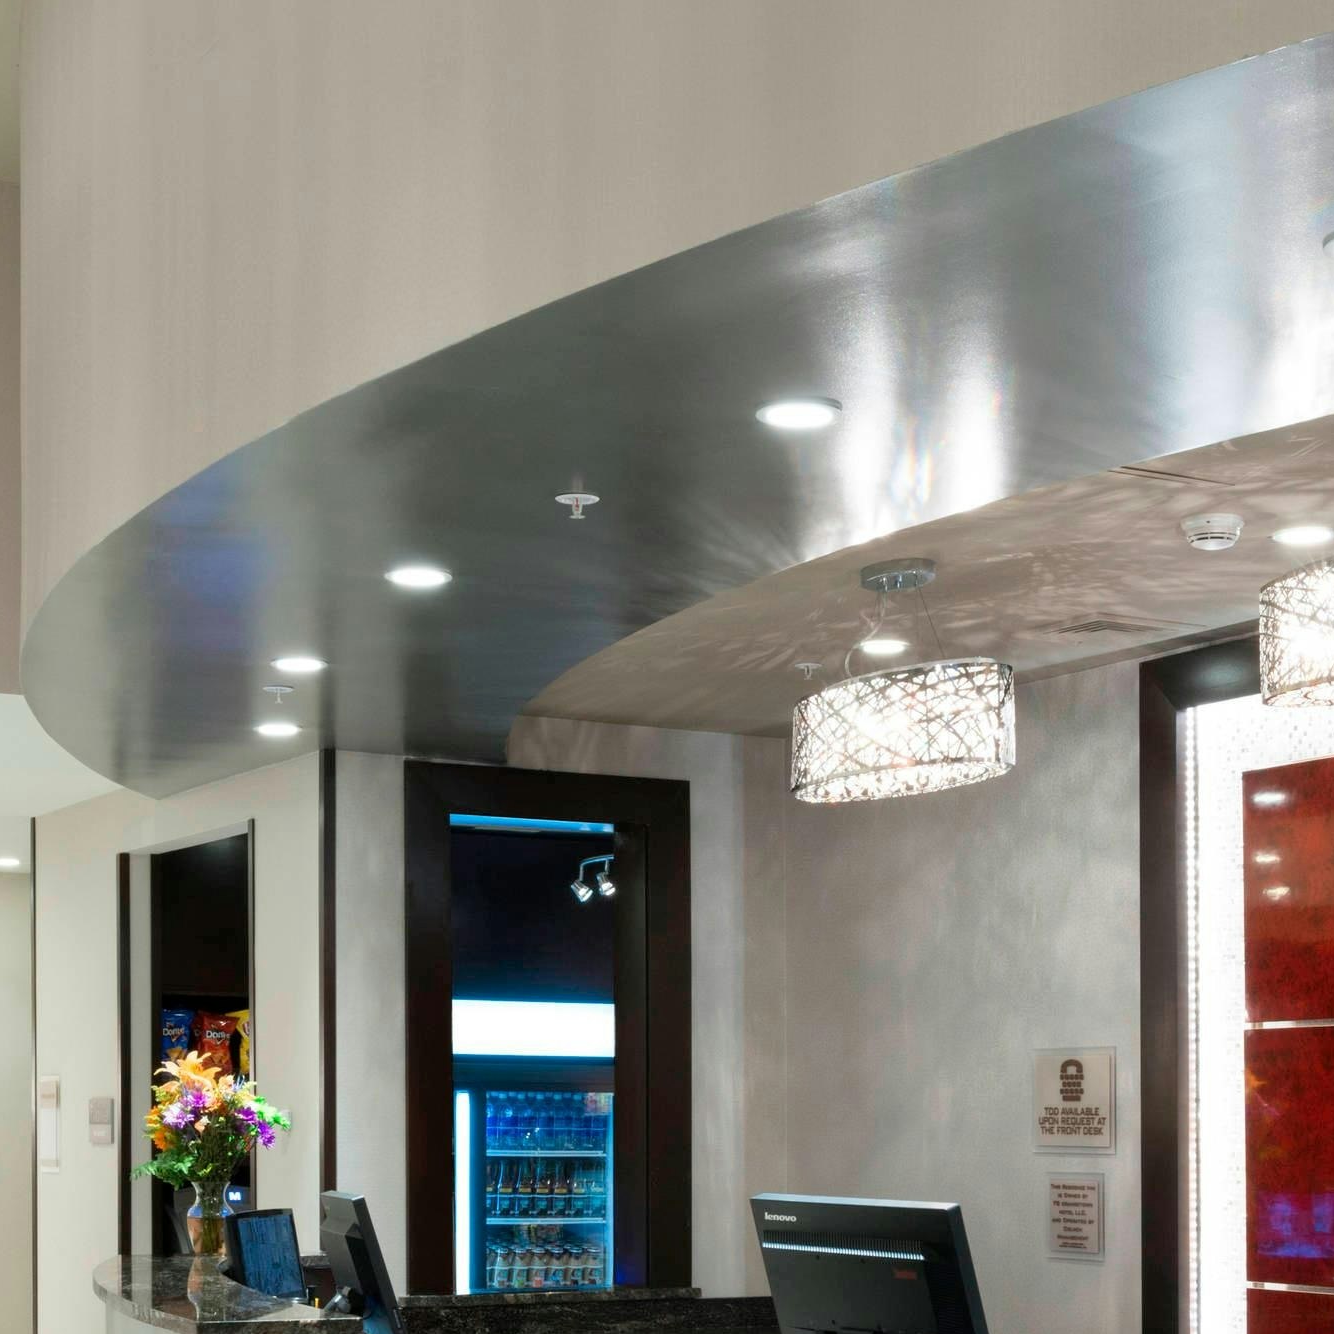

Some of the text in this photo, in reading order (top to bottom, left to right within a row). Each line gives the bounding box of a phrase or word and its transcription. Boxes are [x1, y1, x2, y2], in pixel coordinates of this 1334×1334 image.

[1044, 1107, 1099, 1116] TDD AVAILABLE
[1038, 1116, 1107, 1126] UPON REQUEST AT
[1040, 1126, 1104, 1135] THE FRONT DESK
[765, 1212, 797, 1222] lenovo
